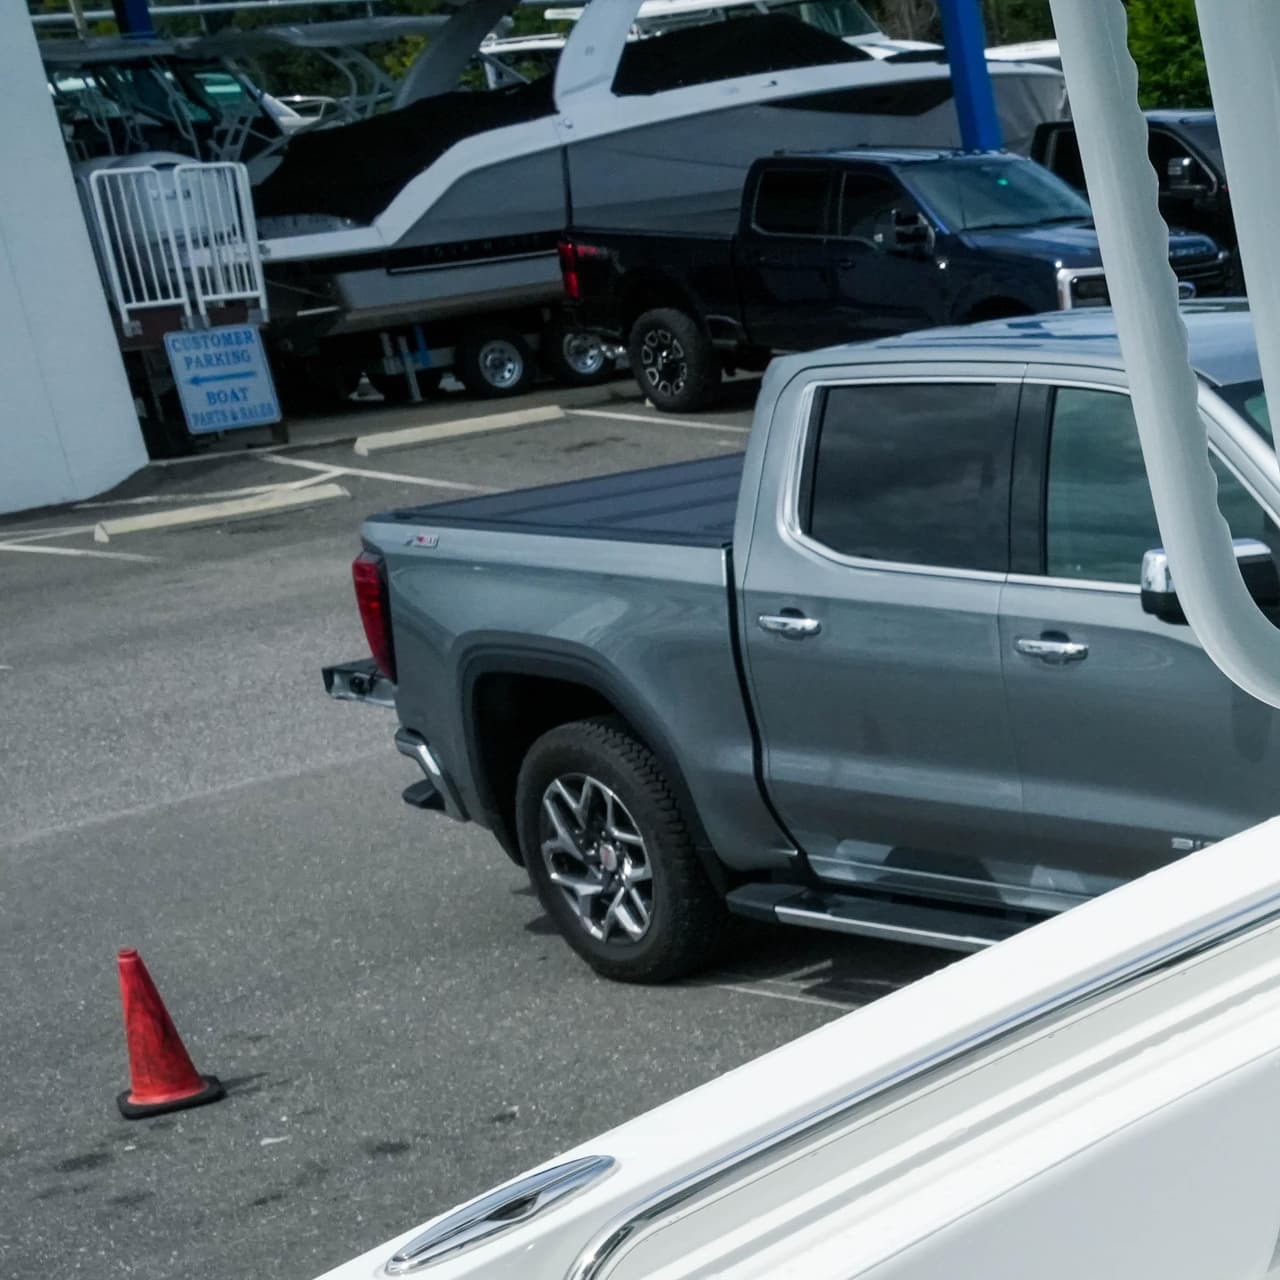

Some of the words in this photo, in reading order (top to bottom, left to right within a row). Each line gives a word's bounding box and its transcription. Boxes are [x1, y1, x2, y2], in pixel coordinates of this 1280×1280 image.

[171, 330, 254, 353] CUSTOMER
[184, 349, 250, 370] PARKING
[206, 387, 249, 406] BOAT
